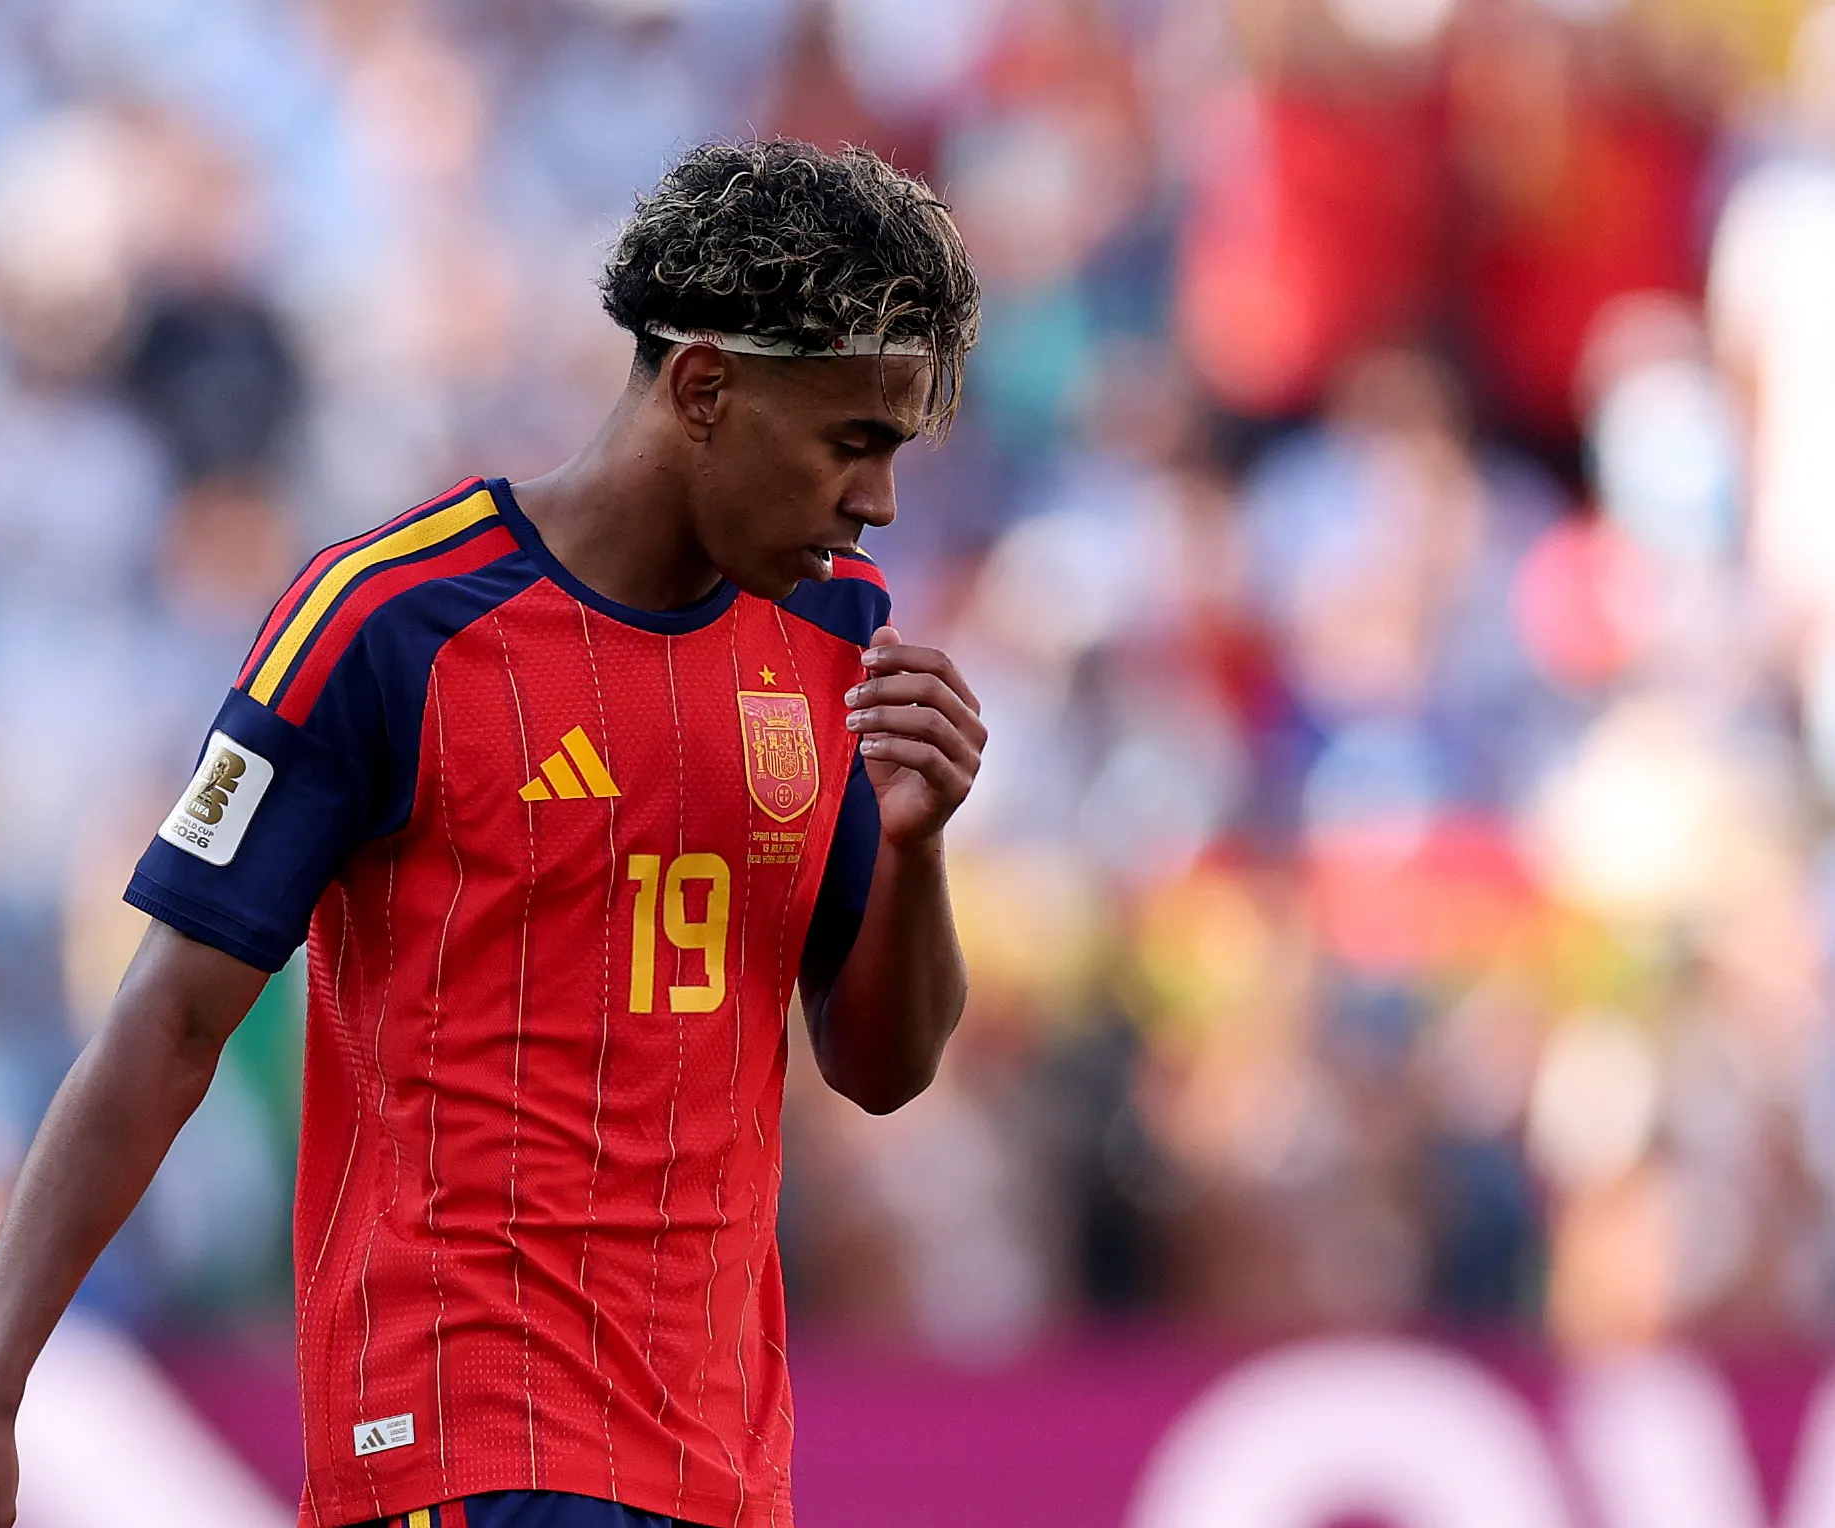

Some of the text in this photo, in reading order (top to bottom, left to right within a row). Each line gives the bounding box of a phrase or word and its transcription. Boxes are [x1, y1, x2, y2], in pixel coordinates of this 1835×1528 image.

[189, 800, 210, 818] FIFA
[172, 822, 210, 849] 2026
[198, 825, 215, 838] CUP
[628, 853, 730, 1013] 19
